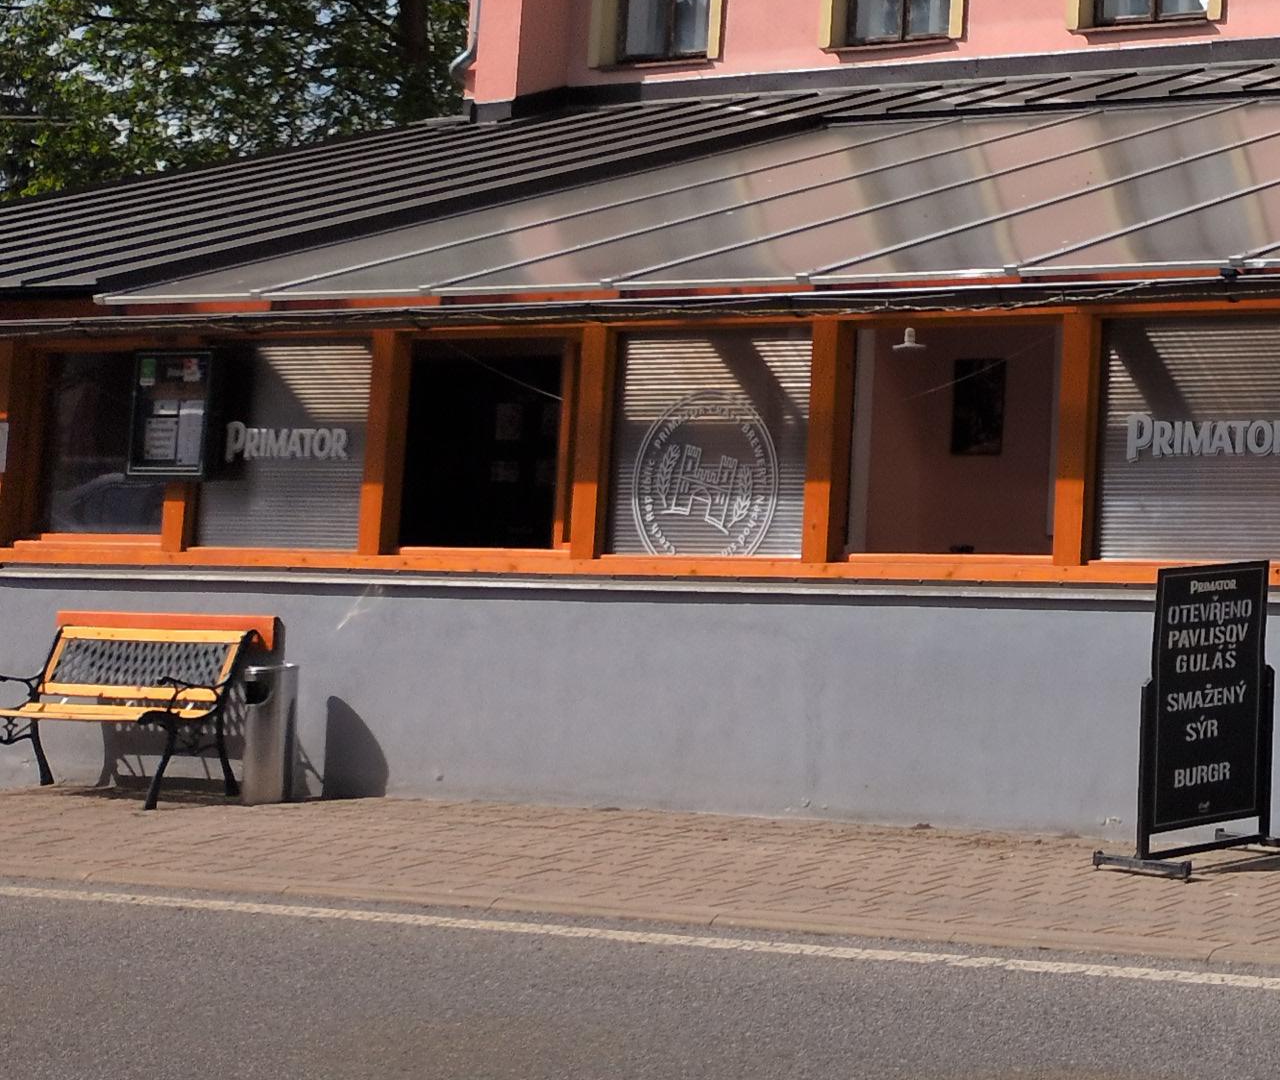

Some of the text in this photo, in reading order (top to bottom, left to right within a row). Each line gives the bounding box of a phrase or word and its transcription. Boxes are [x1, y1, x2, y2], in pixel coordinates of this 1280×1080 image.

[226, 421, 347, 462] PRIMATOR
[1167, 595, 1252, 625] OTEVŘENO
[1175, 643, 1237, 673] GULÁŠ
[1166, 680, 1247, 712] SMAŽENÝ
[1185, 715, 1219, 742] SÝR
[1174, 762, 1231, 788] BURGR
